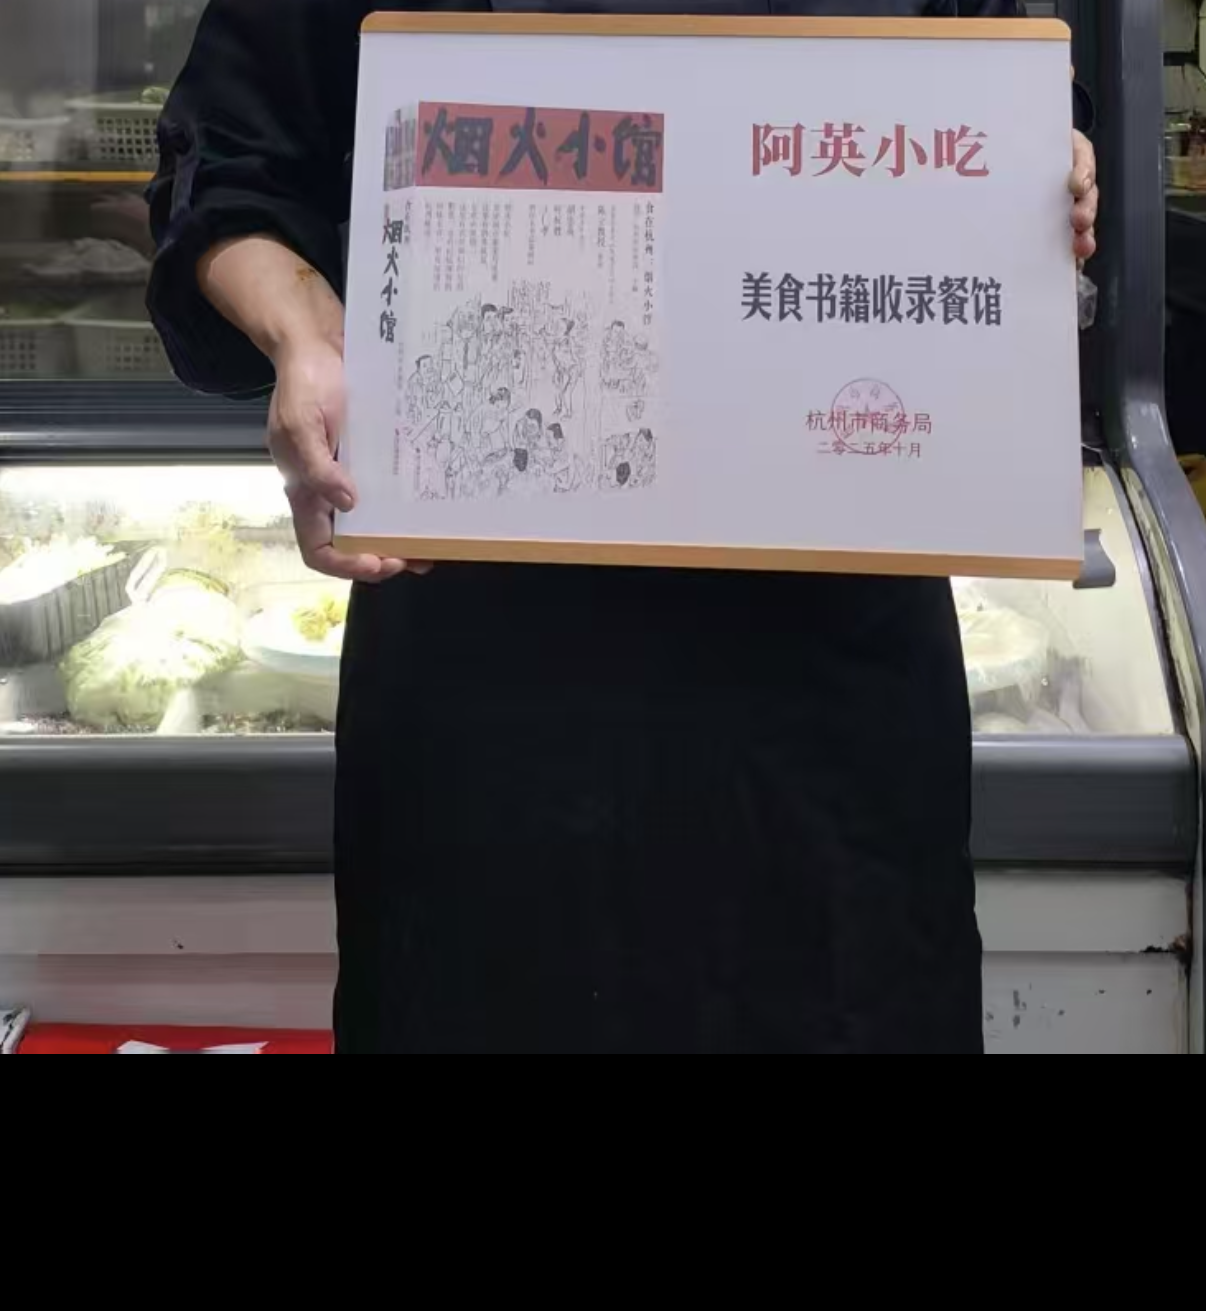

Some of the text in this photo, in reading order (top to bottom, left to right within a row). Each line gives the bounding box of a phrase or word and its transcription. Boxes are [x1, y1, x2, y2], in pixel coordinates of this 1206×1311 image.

[421, 106, 662, 186] 烟火小馆
[752, 122, 990, 178] 阿英小吃
[380, 219, 404, 343] 烟火小馆
[741, 272, 1002, 326] 美食书籍收录餐馆
[806, 410, 932, 434] 杭州市商务局
